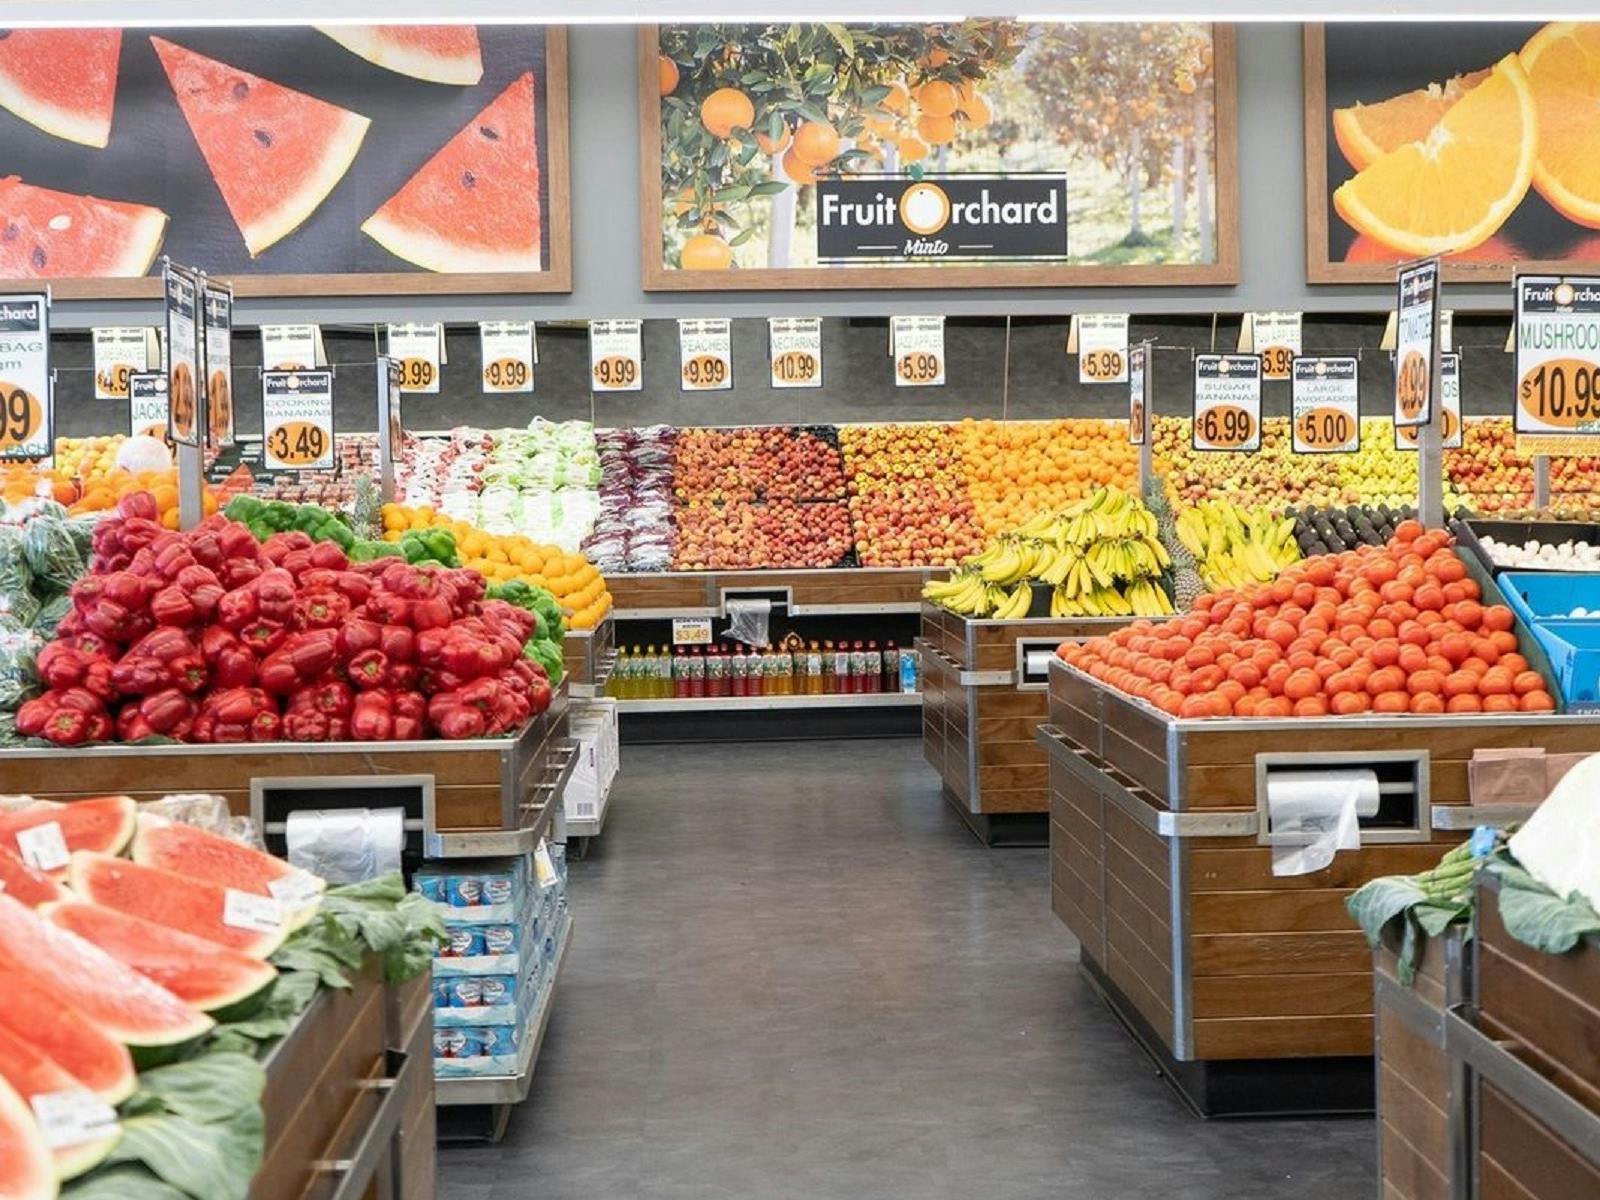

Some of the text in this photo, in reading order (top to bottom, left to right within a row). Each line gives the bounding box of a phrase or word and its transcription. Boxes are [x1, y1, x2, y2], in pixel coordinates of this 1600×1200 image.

[822, 181, 1058, 236] Fruit Orchard
[903, 238, 949, 255] Minto
[1525, 288, 1554, 301] Fruit
[1520, 324, 1600, 350] MUSHROO
[485, 362, 526, 386] $9.99
[594, 359, 636, 383] $9.99
[684, 360, 725, 383] $9.99
[774, 355, 814, 379] $10.99
[898, 355, 938, 379] $5.99
[1082, 353, 1122, 377] $5.99
[1199, 361, 1217, 371] Fruit
[1296, 363, 1314, 373] Fruit
[98, 367, 137, 392] $4.9
[135, 380, 153, 391] Fruit
[267, 378, 286, 388] Fruit
[1204, 383, 1251, 391] SUGAR
[265, 399, 330, 407] COOKING
[1196, 392, 1259, 401] BANANAS
[1296, 395, 1357, 403] AVOCADOS
[265, 409, 331, 417] BANANAS
[1197, 409, 1250, 442] $6.99
[1299, 414, 1347, 443] $5.00
[267, 426, 322, 459] $3.49
